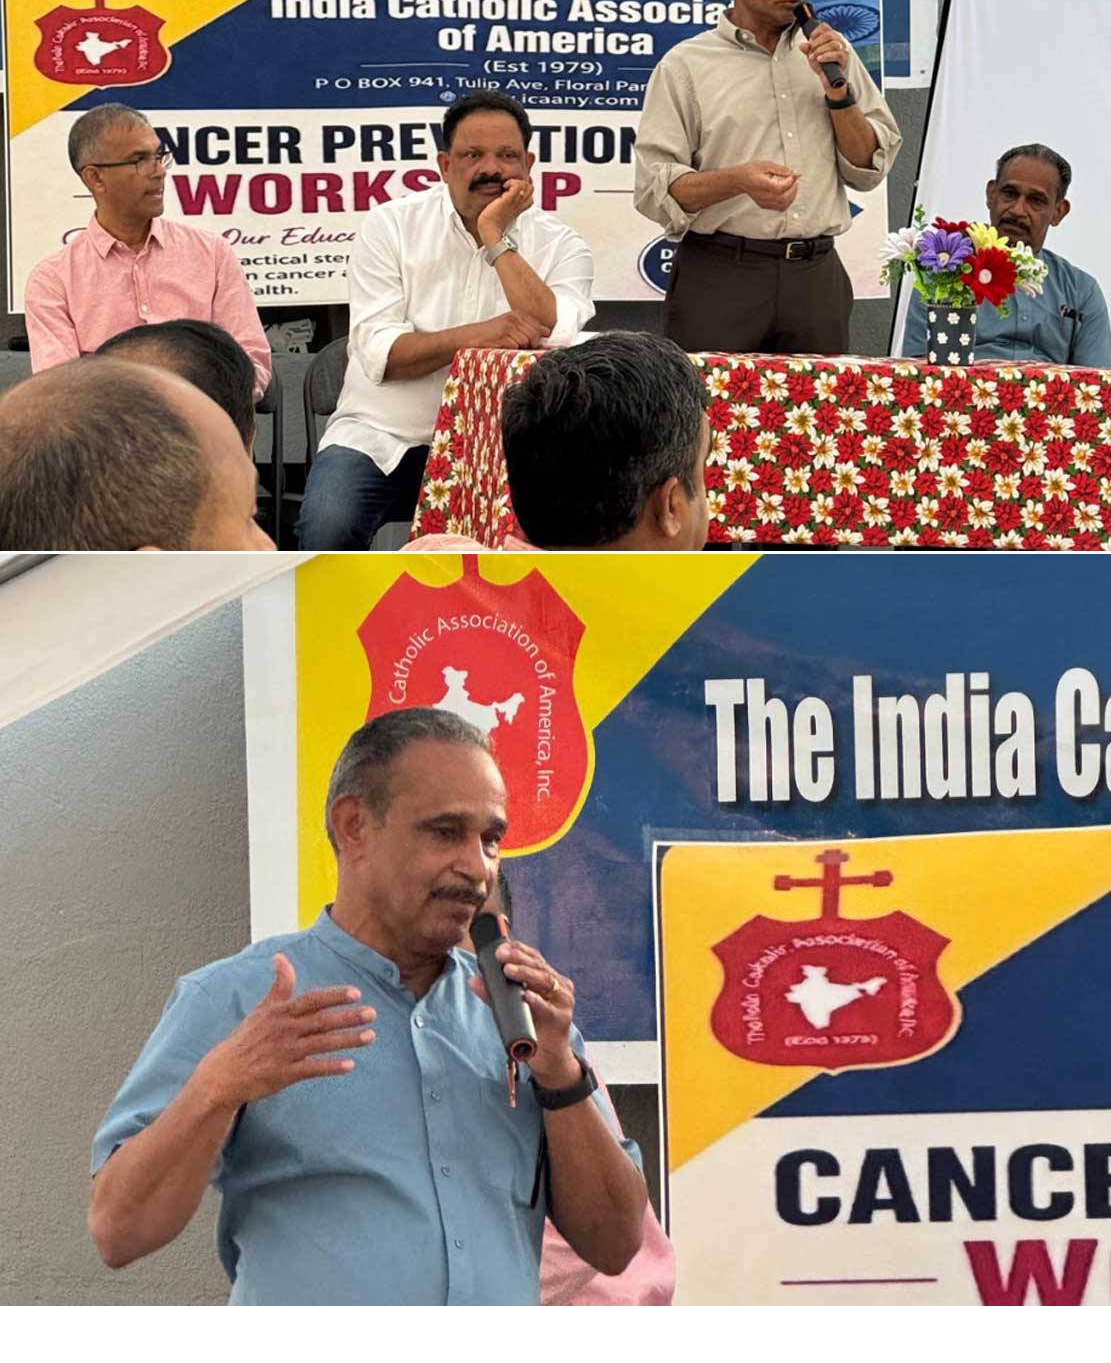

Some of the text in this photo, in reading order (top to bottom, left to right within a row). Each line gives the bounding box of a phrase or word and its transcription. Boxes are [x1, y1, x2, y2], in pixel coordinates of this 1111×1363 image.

[438, 24, 654, 55] of America
[483, 60, 603, 75] (Est 1979)
[315, 78, 328, 89] P
[334, 77, 351, 89] O
[358, 77, 402, 88] BOX
[455, 76, 501, 91] Tulip
[506, 78, 548, 92] Ave,
[554, 78, 610, 92] Floral
[240, 253, 307, 266] actical
[264, 270, 336, 281] cancer
[253, 284, 299, 296] alth.
[388, 613, 557, 803] Catholic Association of America, Inc.
[704, 677, 835, 803] The
[852, 671, 1037, 800] India
